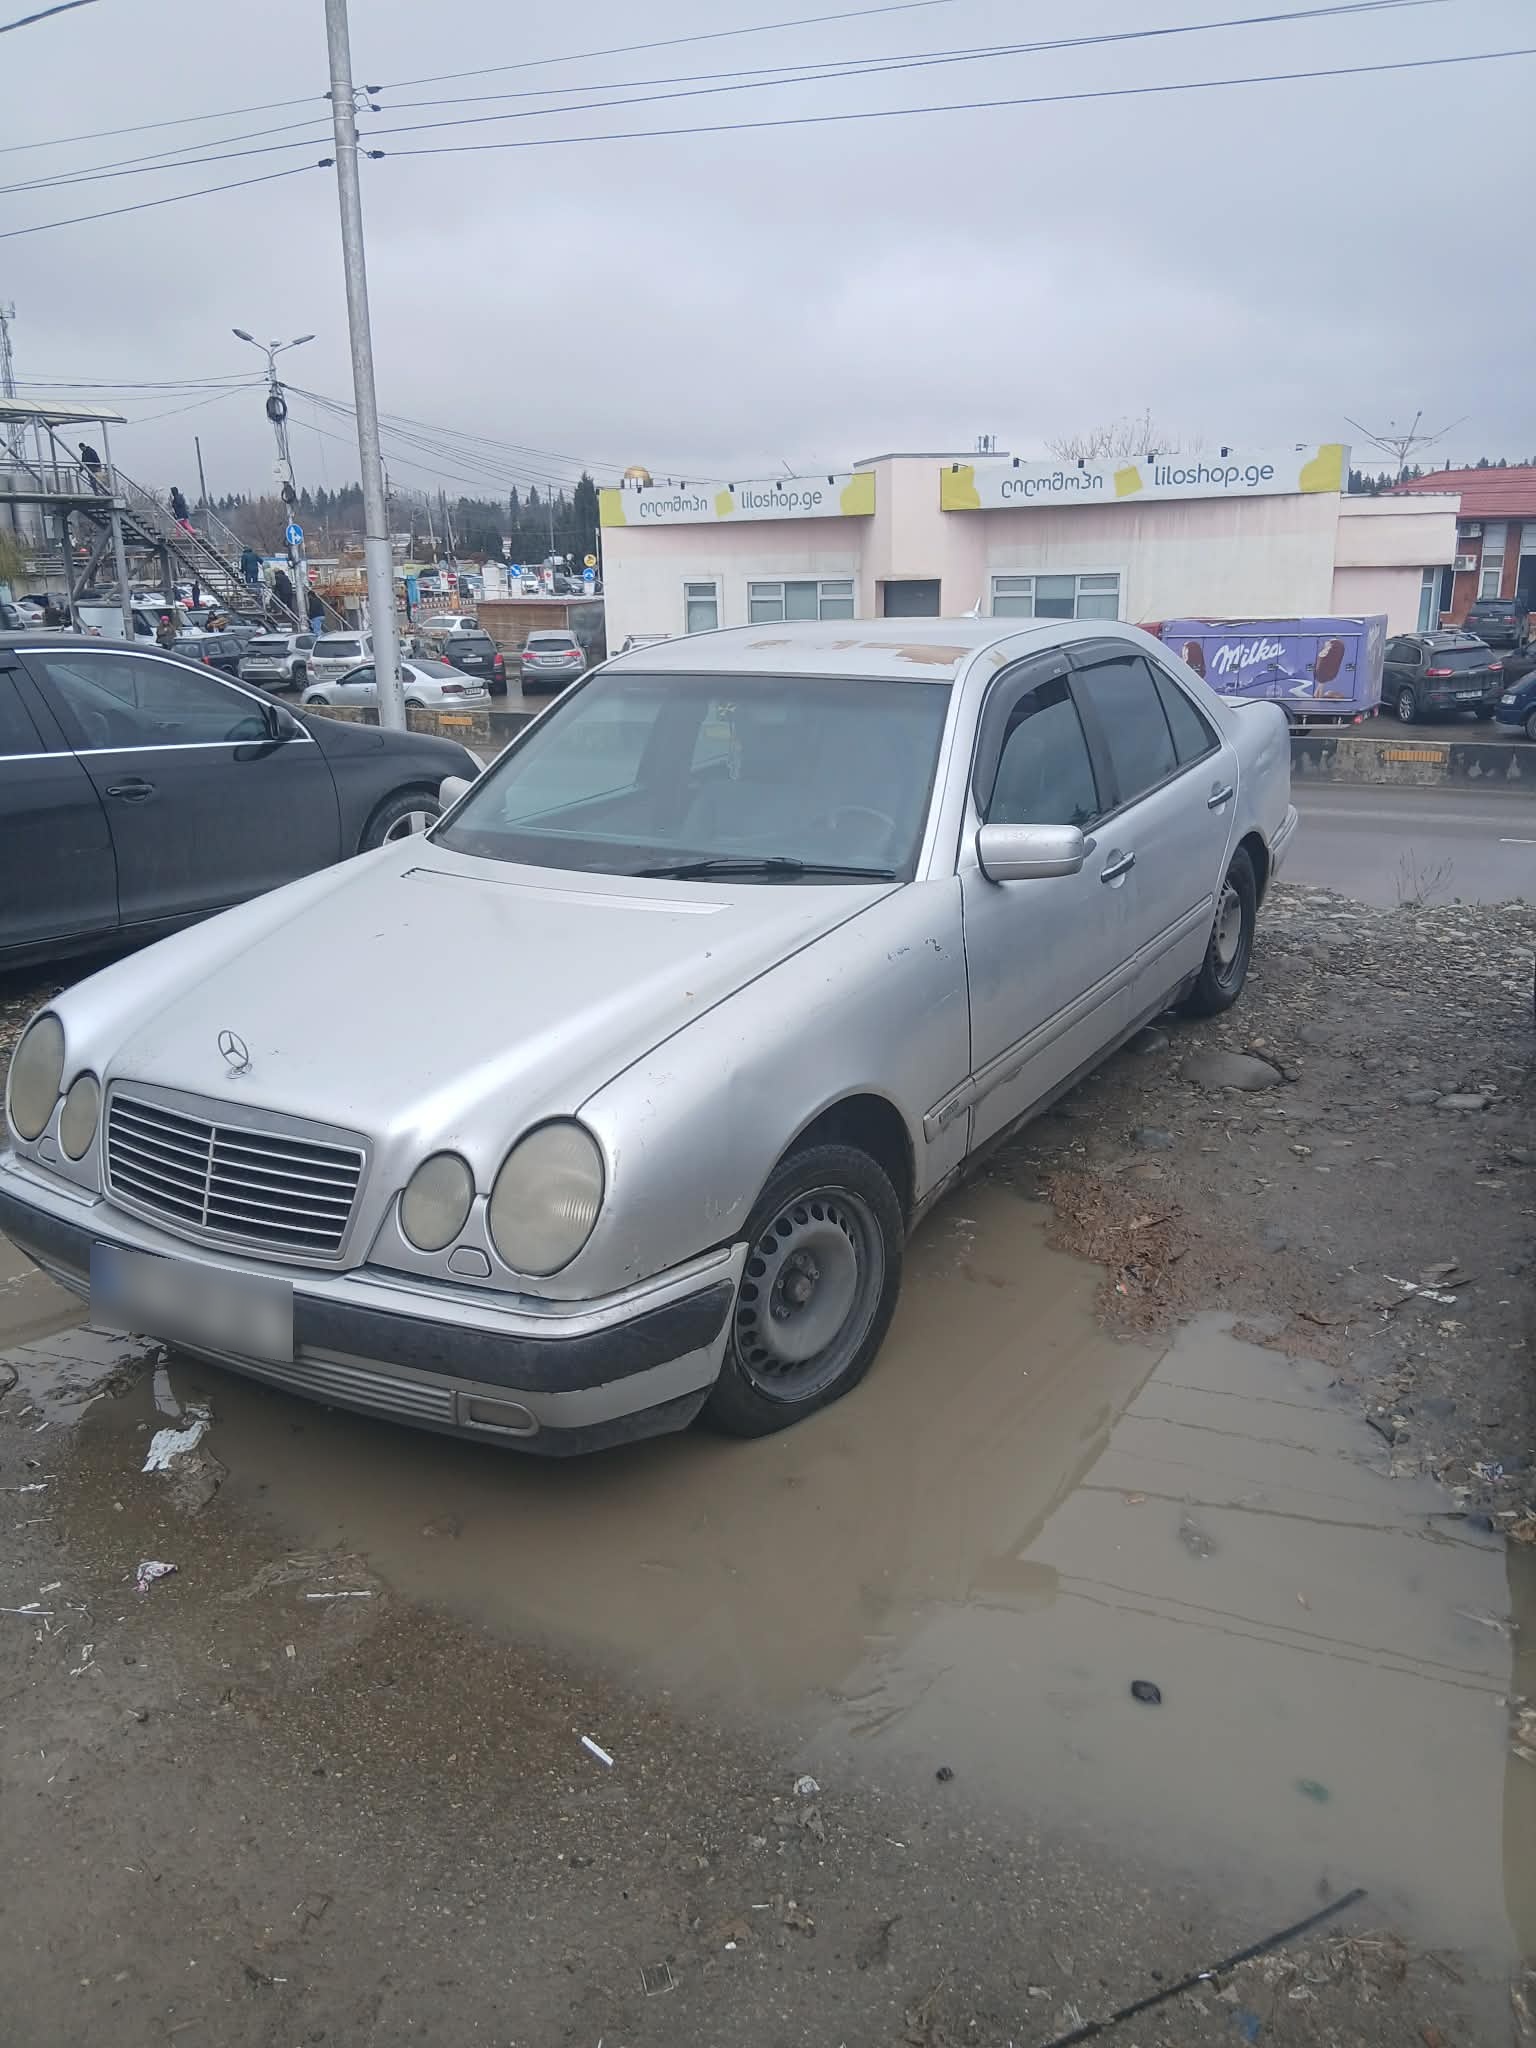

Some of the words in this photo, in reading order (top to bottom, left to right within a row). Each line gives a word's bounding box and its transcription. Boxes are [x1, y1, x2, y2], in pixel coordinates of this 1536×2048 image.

[1002, 471, 1103, 498] ლილოშოპი
[1155, 463, 1274, 487] liloshop.ge
[640, 496, 708, 517] ლილოშოპი
[741, 489, 822, 511] liloshop.ge
[1211, 638, 1286, 675] Milka
